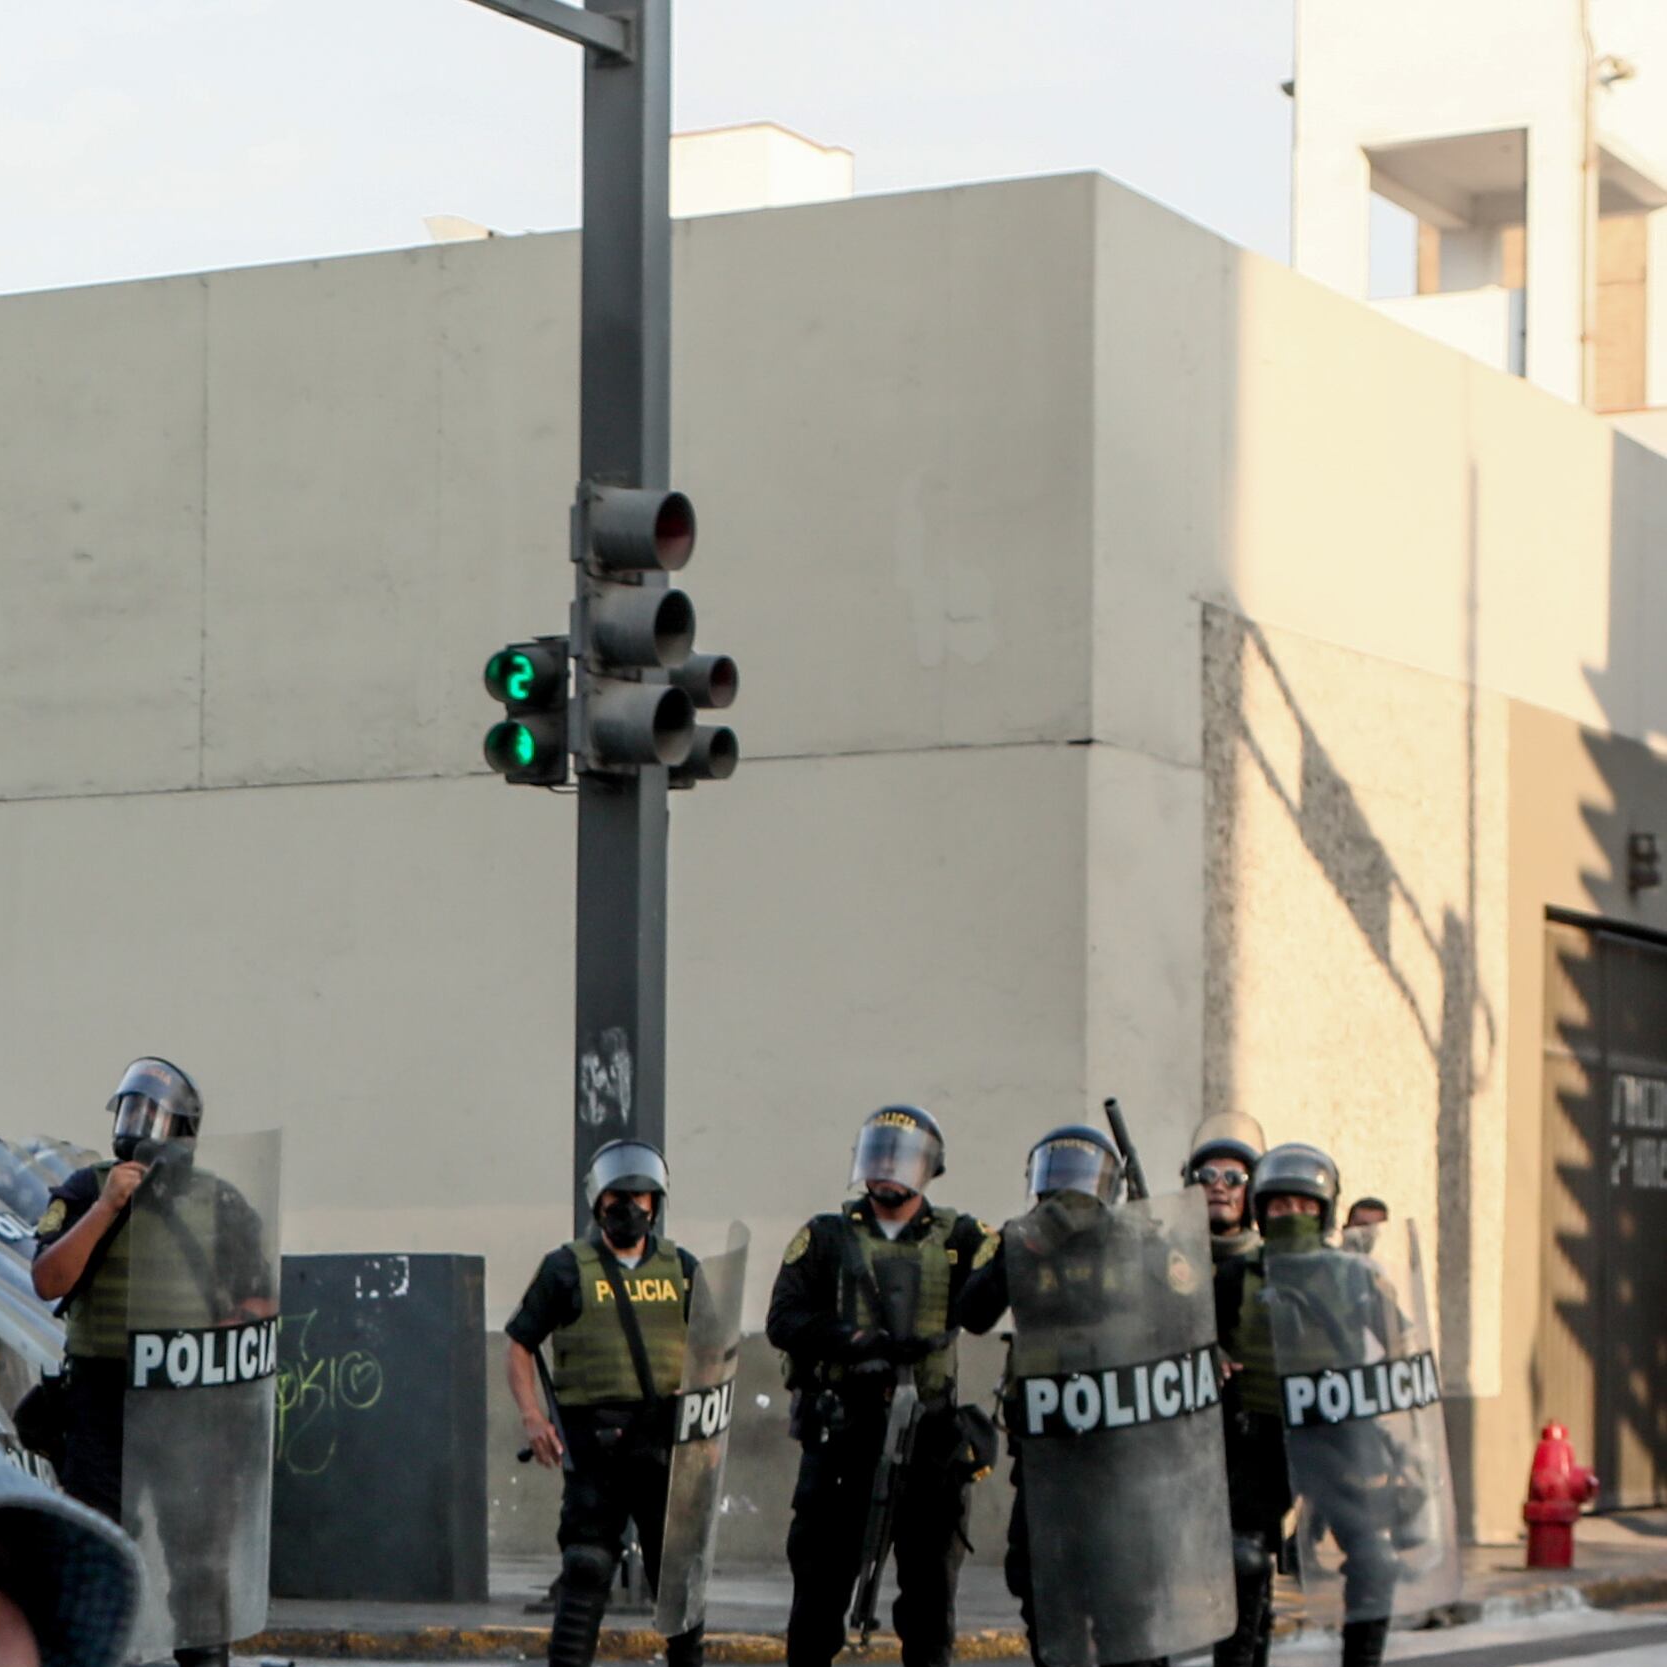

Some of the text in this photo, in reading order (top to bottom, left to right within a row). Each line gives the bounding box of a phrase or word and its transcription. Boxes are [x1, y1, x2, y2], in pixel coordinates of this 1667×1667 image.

[595, 1279, 679, 1302] PLICIA
[134, 1321, 277, 1388] POLICIA
[1024, 1349, 1219, 1434] POLICIA
[1284, 1354, 1439, 1425] POLICIA
